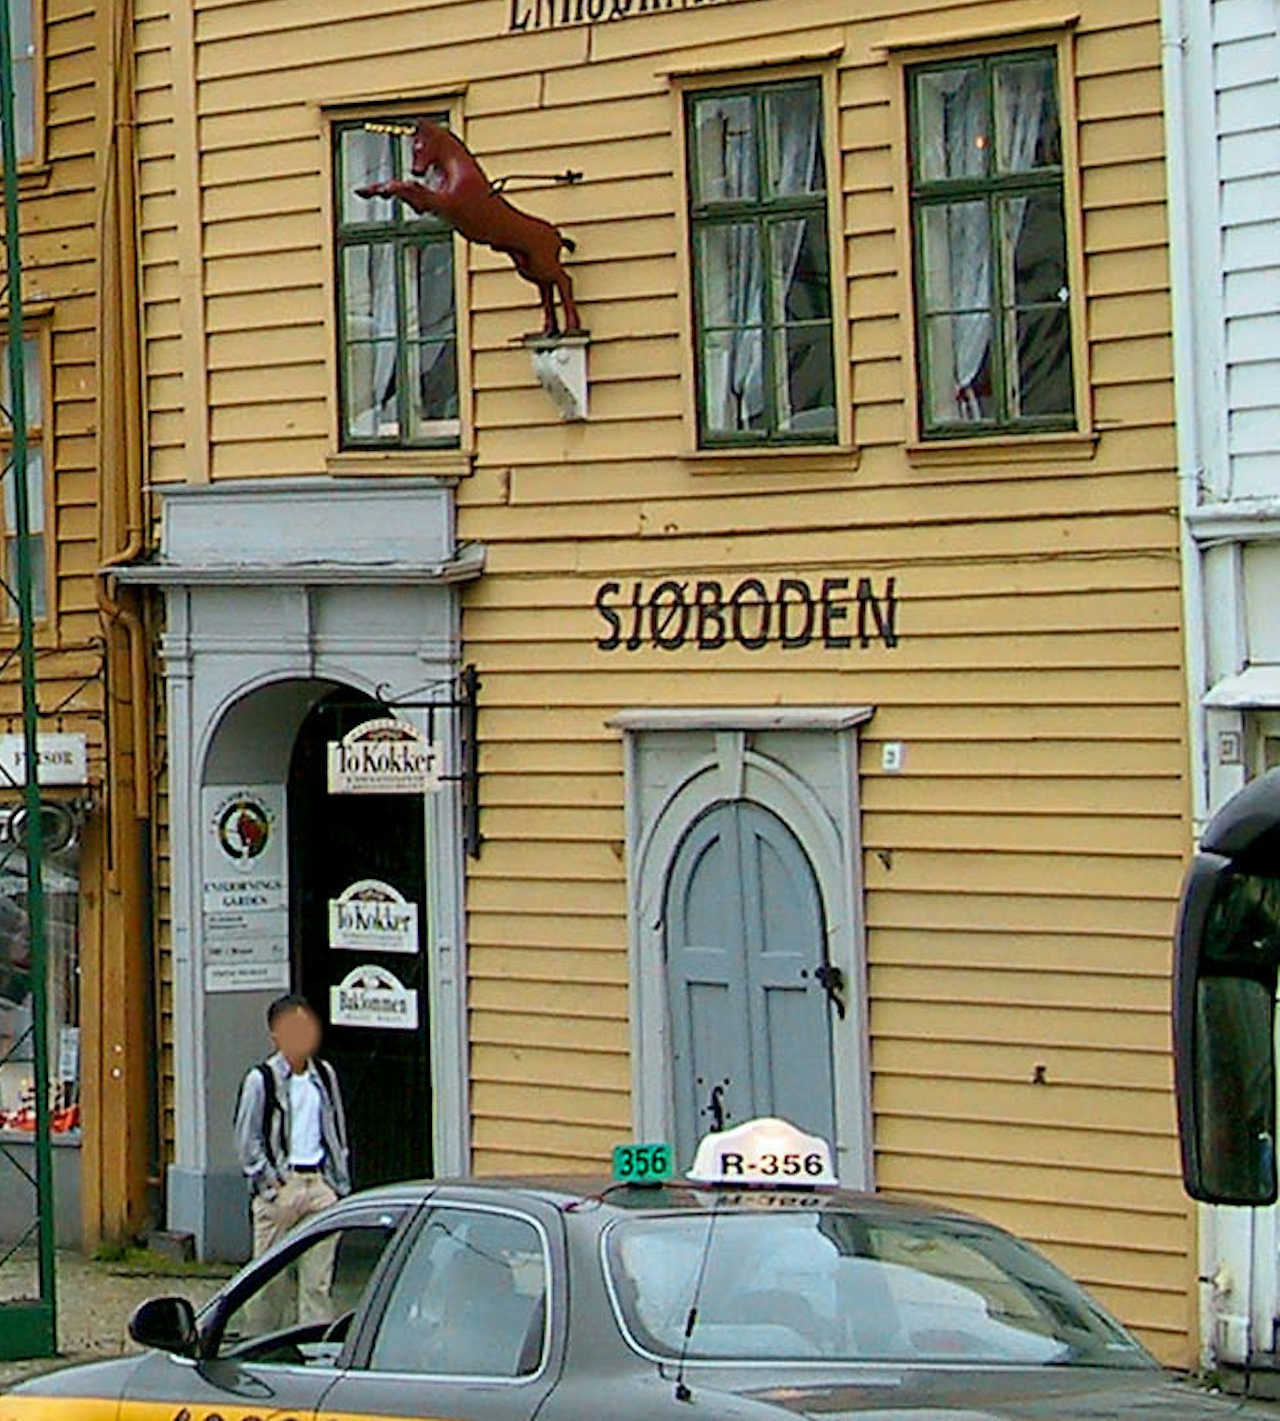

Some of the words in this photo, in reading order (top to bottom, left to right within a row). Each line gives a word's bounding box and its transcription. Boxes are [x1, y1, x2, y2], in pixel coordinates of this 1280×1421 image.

[594, 577, 899, 650] SJØBODEN
[336, 743, 360, 774] To
[362, 739, 435, 774] Kokker
[619, 1147, 668, 1177] 356
[720, 1153, 824, 1176] R-356
